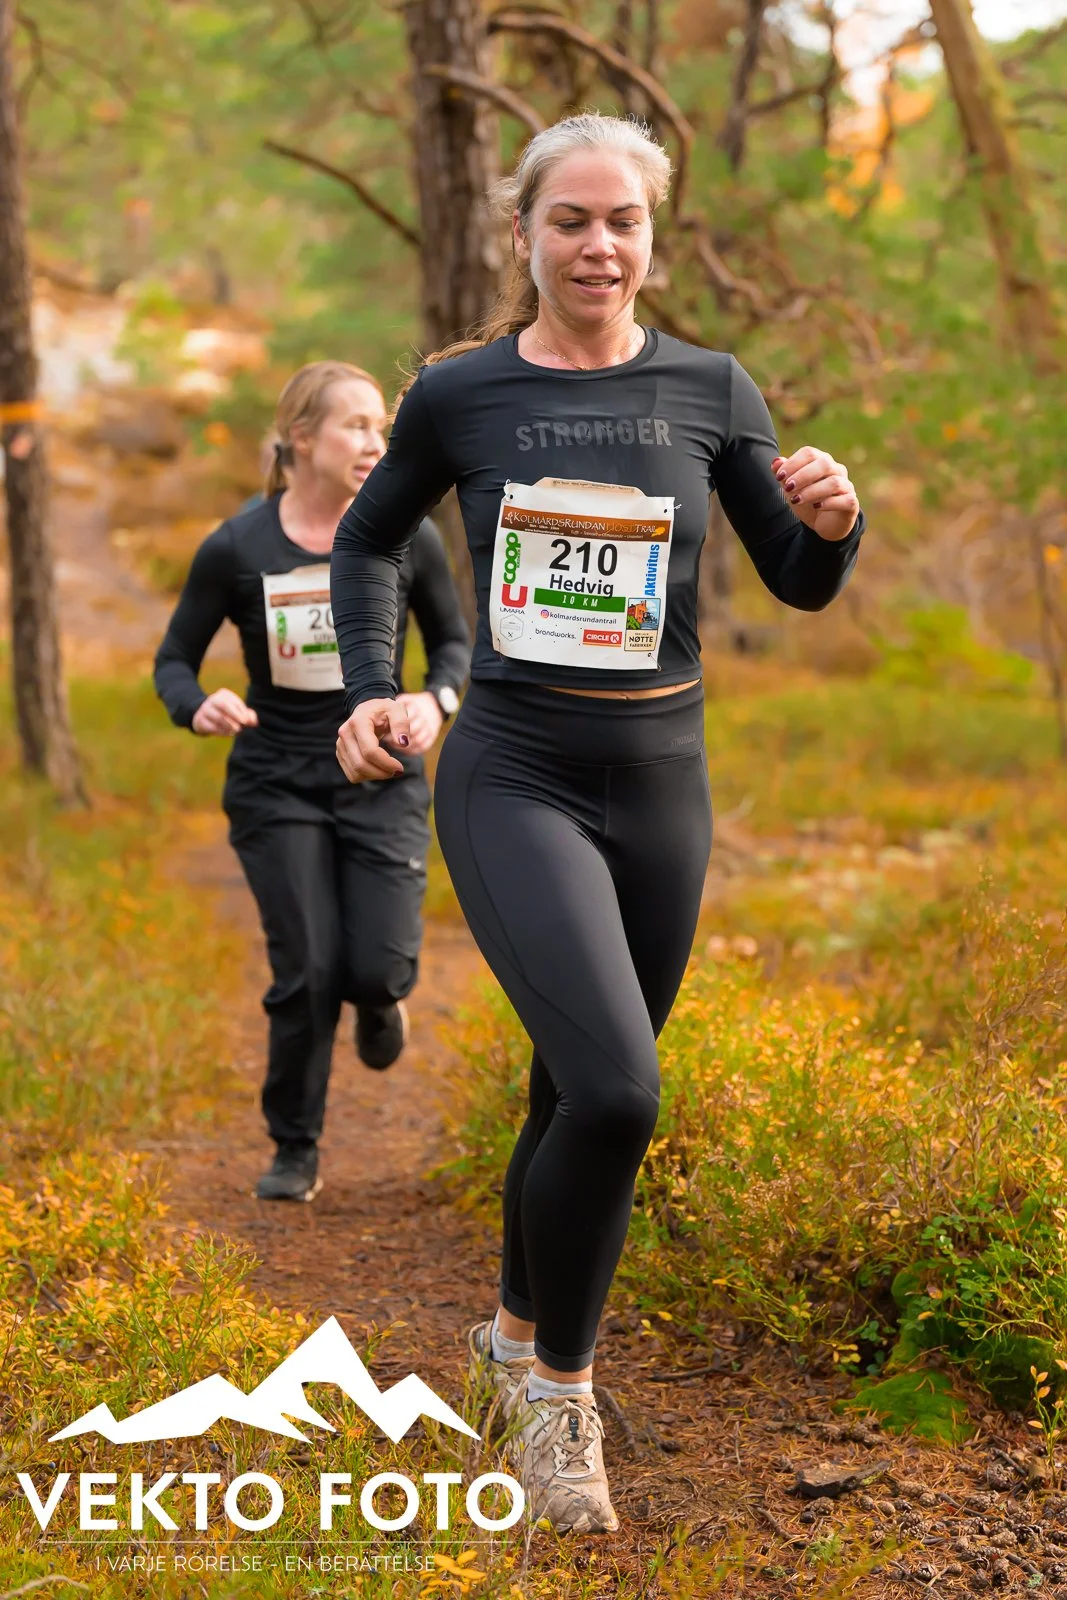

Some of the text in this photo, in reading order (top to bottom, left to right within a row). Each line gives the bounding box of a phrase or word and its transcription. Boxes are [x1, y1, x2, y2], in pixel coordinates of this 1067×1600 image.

[515, 418, 672, 451] STRONGER
[503, 532, 521, 584] coop
[549, 538, 618, 576] 210
[644, 544, 660, 597] Aktivitus
[549, 573, 614, 599] Hedvig
[499, 607, 526, 615] UMARA
[562, 595, 598, 607] 10 KM
[549, 611, 617, 625] kolmardsrundantrail
[586, 633, 610, 642] CIRCLE
